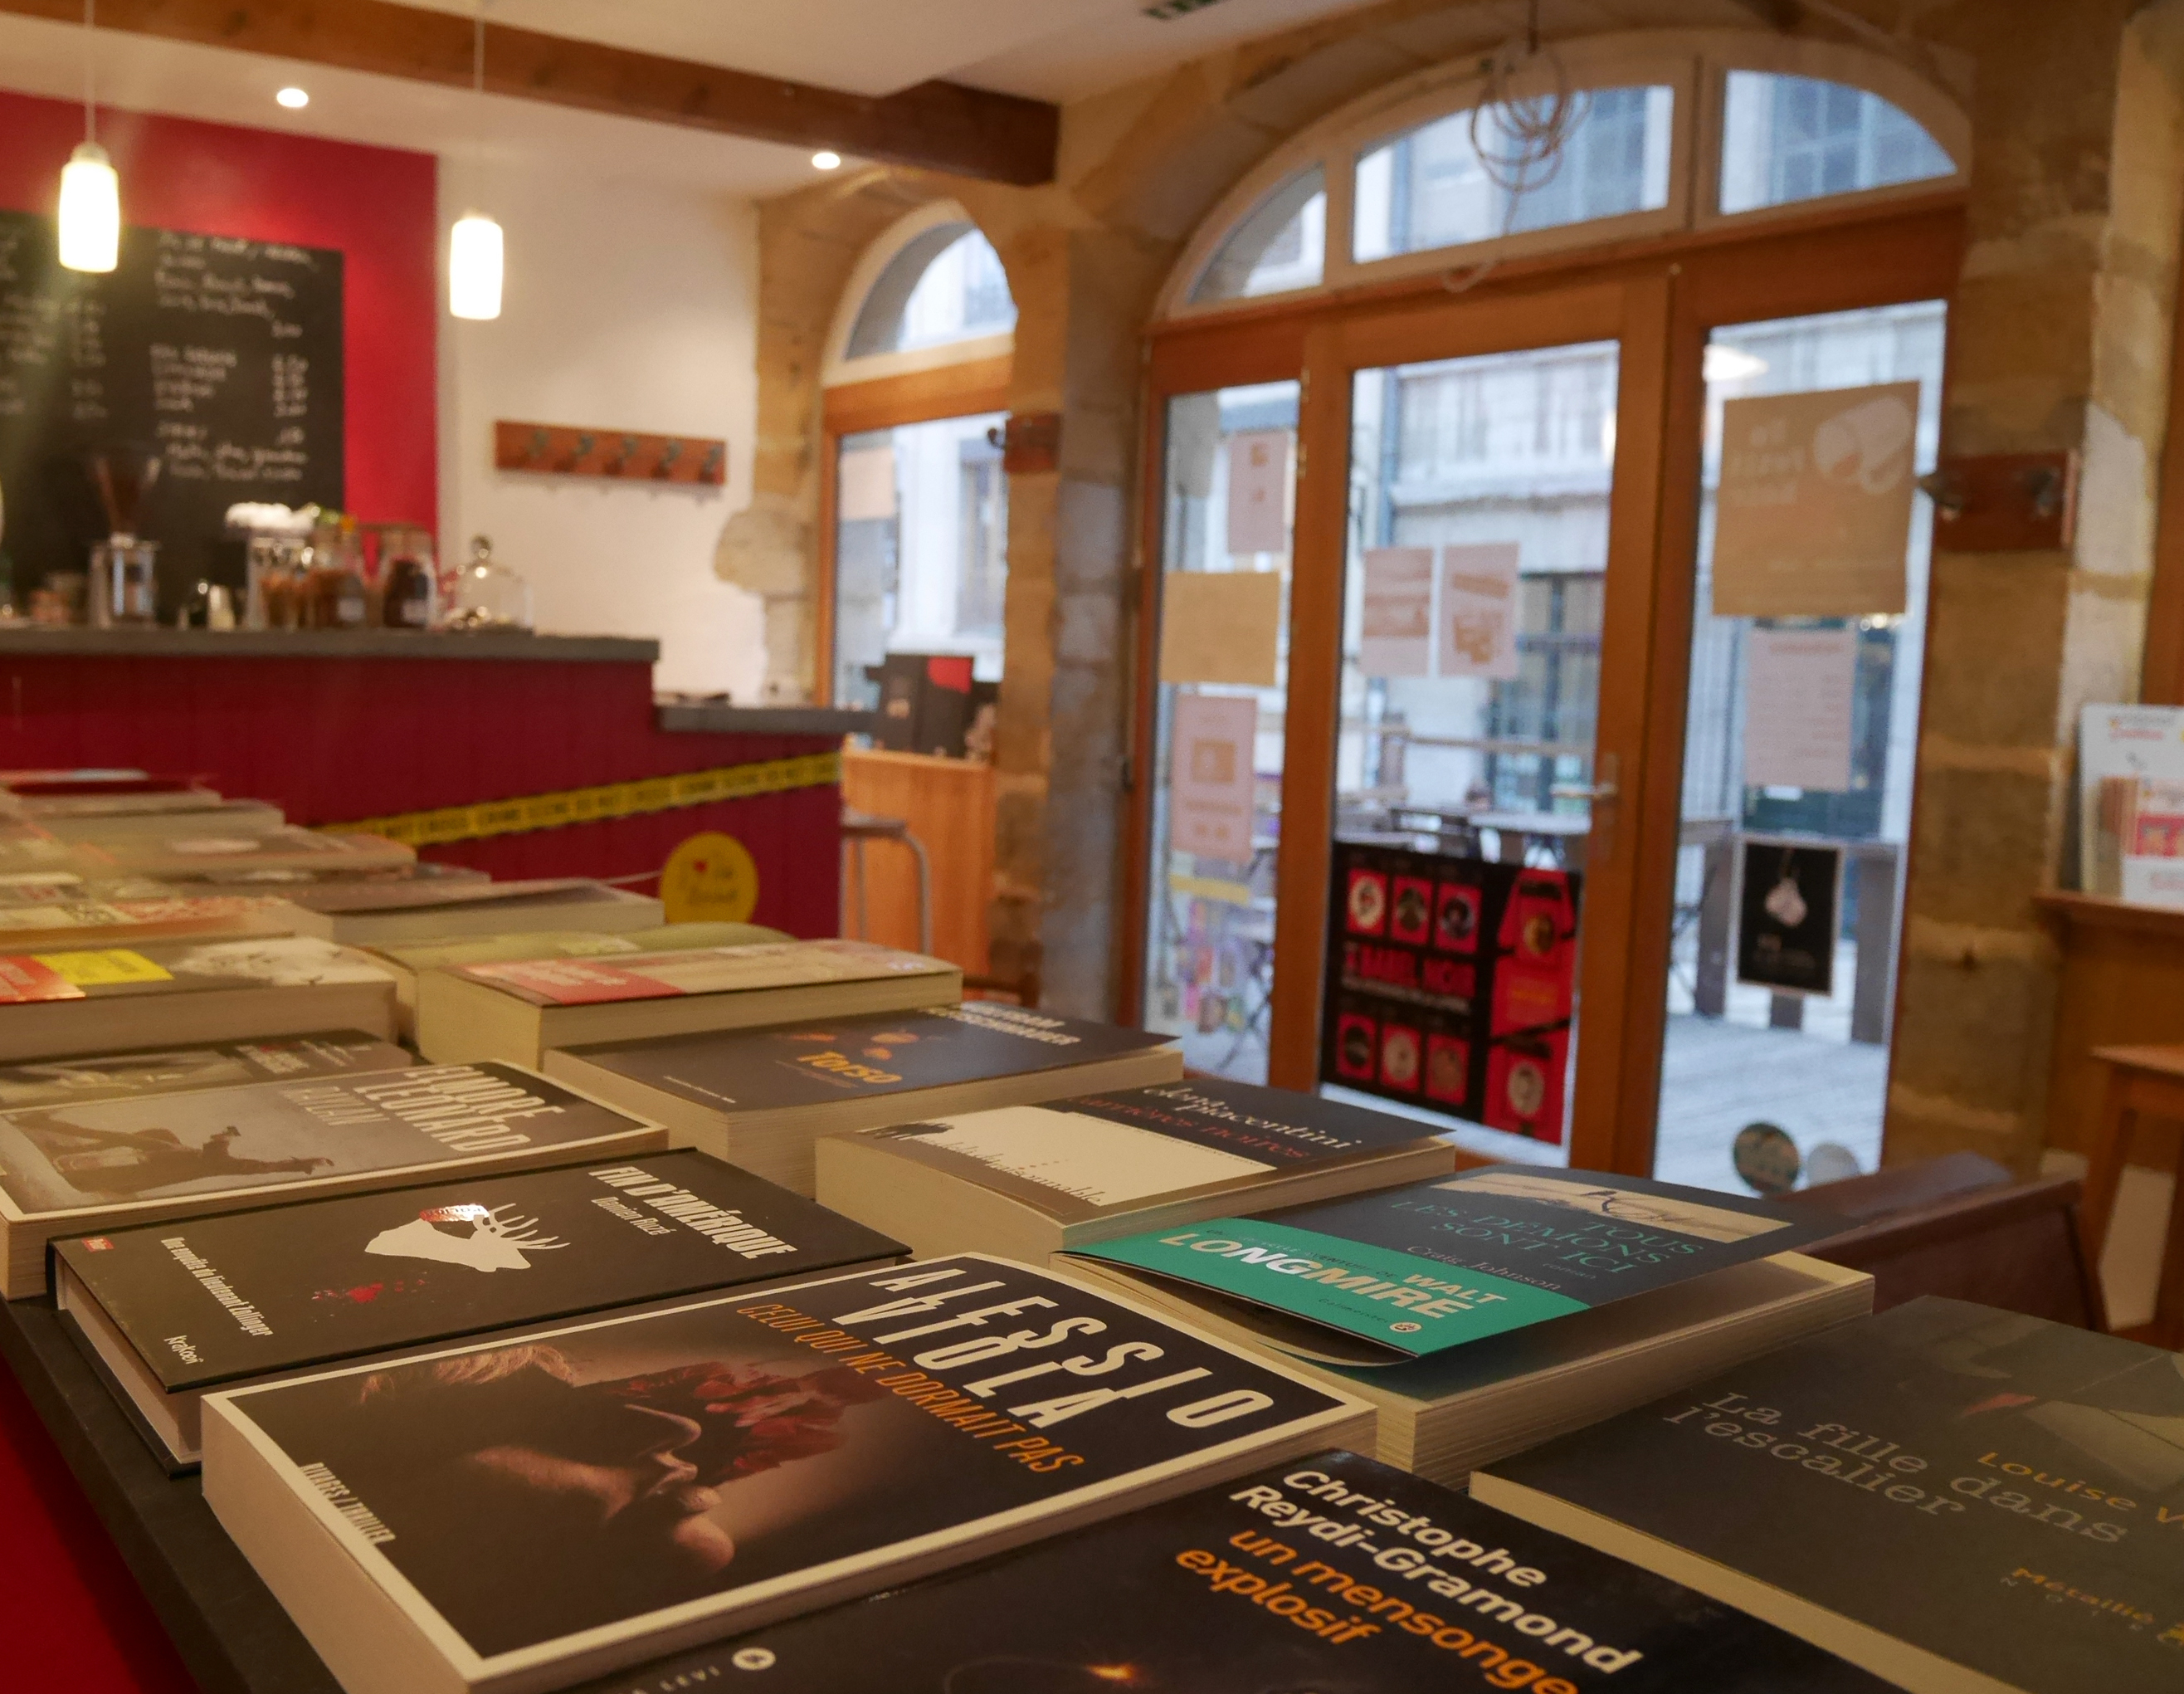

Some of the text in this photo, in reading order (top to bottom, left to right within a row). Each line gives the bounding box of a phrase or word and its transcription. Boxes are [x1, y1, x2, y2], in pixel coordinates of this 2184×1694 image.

[404, 1066, 566, 1123] ELMORE
[798, 1051, 904, 1085] Torso
[353, 1079, 532, 1153] LEONARD
[1173, 1103, 1363, 1149] piacentini
[588, 1166, 798, 1259] FIN D'AMÉRIQUE
[592, 1196, 644, 1220] Damien
[1392, 1199, 1473, 1227] LES
[1583, 1218, 1704, 1257] TOUS
[1158, 1233, 1480, 1320] LONGMIRE
[1406, 1244, 1561, 1291] Craig Johnson
[1433, 1220, 1639, 1274] SONT ICI
[199, 1275, 250, 1309] lieutenant
[1402, 1273, 1508, 1306] WALT
[831, 1295, 1122, 1429] VIOLA
[869, 1267, 1273, 1428] ALESSIO
[737, 1303, 1085, 1473] CELUI QUI NE DORMAIT PAS
[1662, 1406, 1967, 1516] l'escalier
[1702, 1391, 1783, 1426] La
[1797, 1423, 1929, 1475] fille
[1948, 1476, 2128, 1544] dans
[1977, 1451, 2138, 1512] Louise
[1282, 1470, 1548, 1589] Christophe
[1175, 1548, 1382, 1646] explosif
[1228, 1484, 1645, 1675] Reydi-Gramond
[1228, 1530, 1579, 1694] un mensonge
